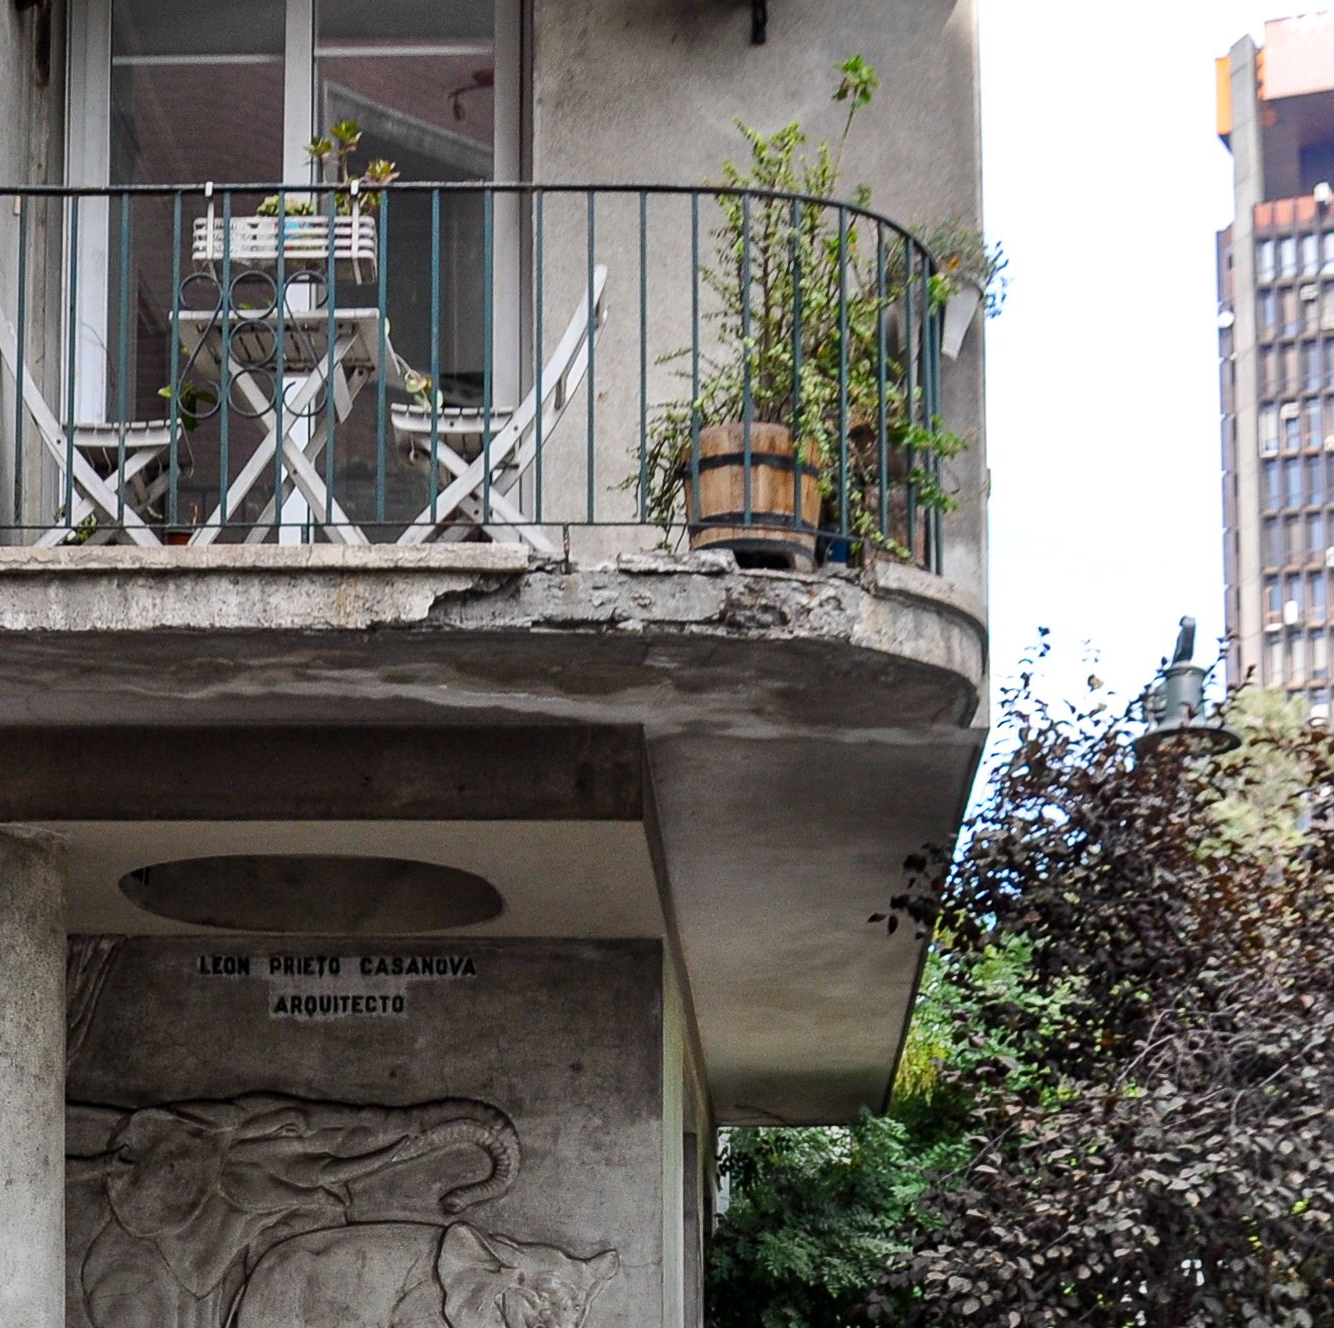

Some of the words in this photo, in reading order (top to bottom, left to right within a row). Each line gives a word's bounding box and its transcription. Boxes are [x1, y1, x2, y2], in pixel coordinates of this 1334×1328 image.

[199, 955, 250, 976] LEON
[269, 956, 341, 978] PRIETO
[359, 957, 476, 977] CASANOVA
[273, 995, 405, 1017] ARQUITECTO
